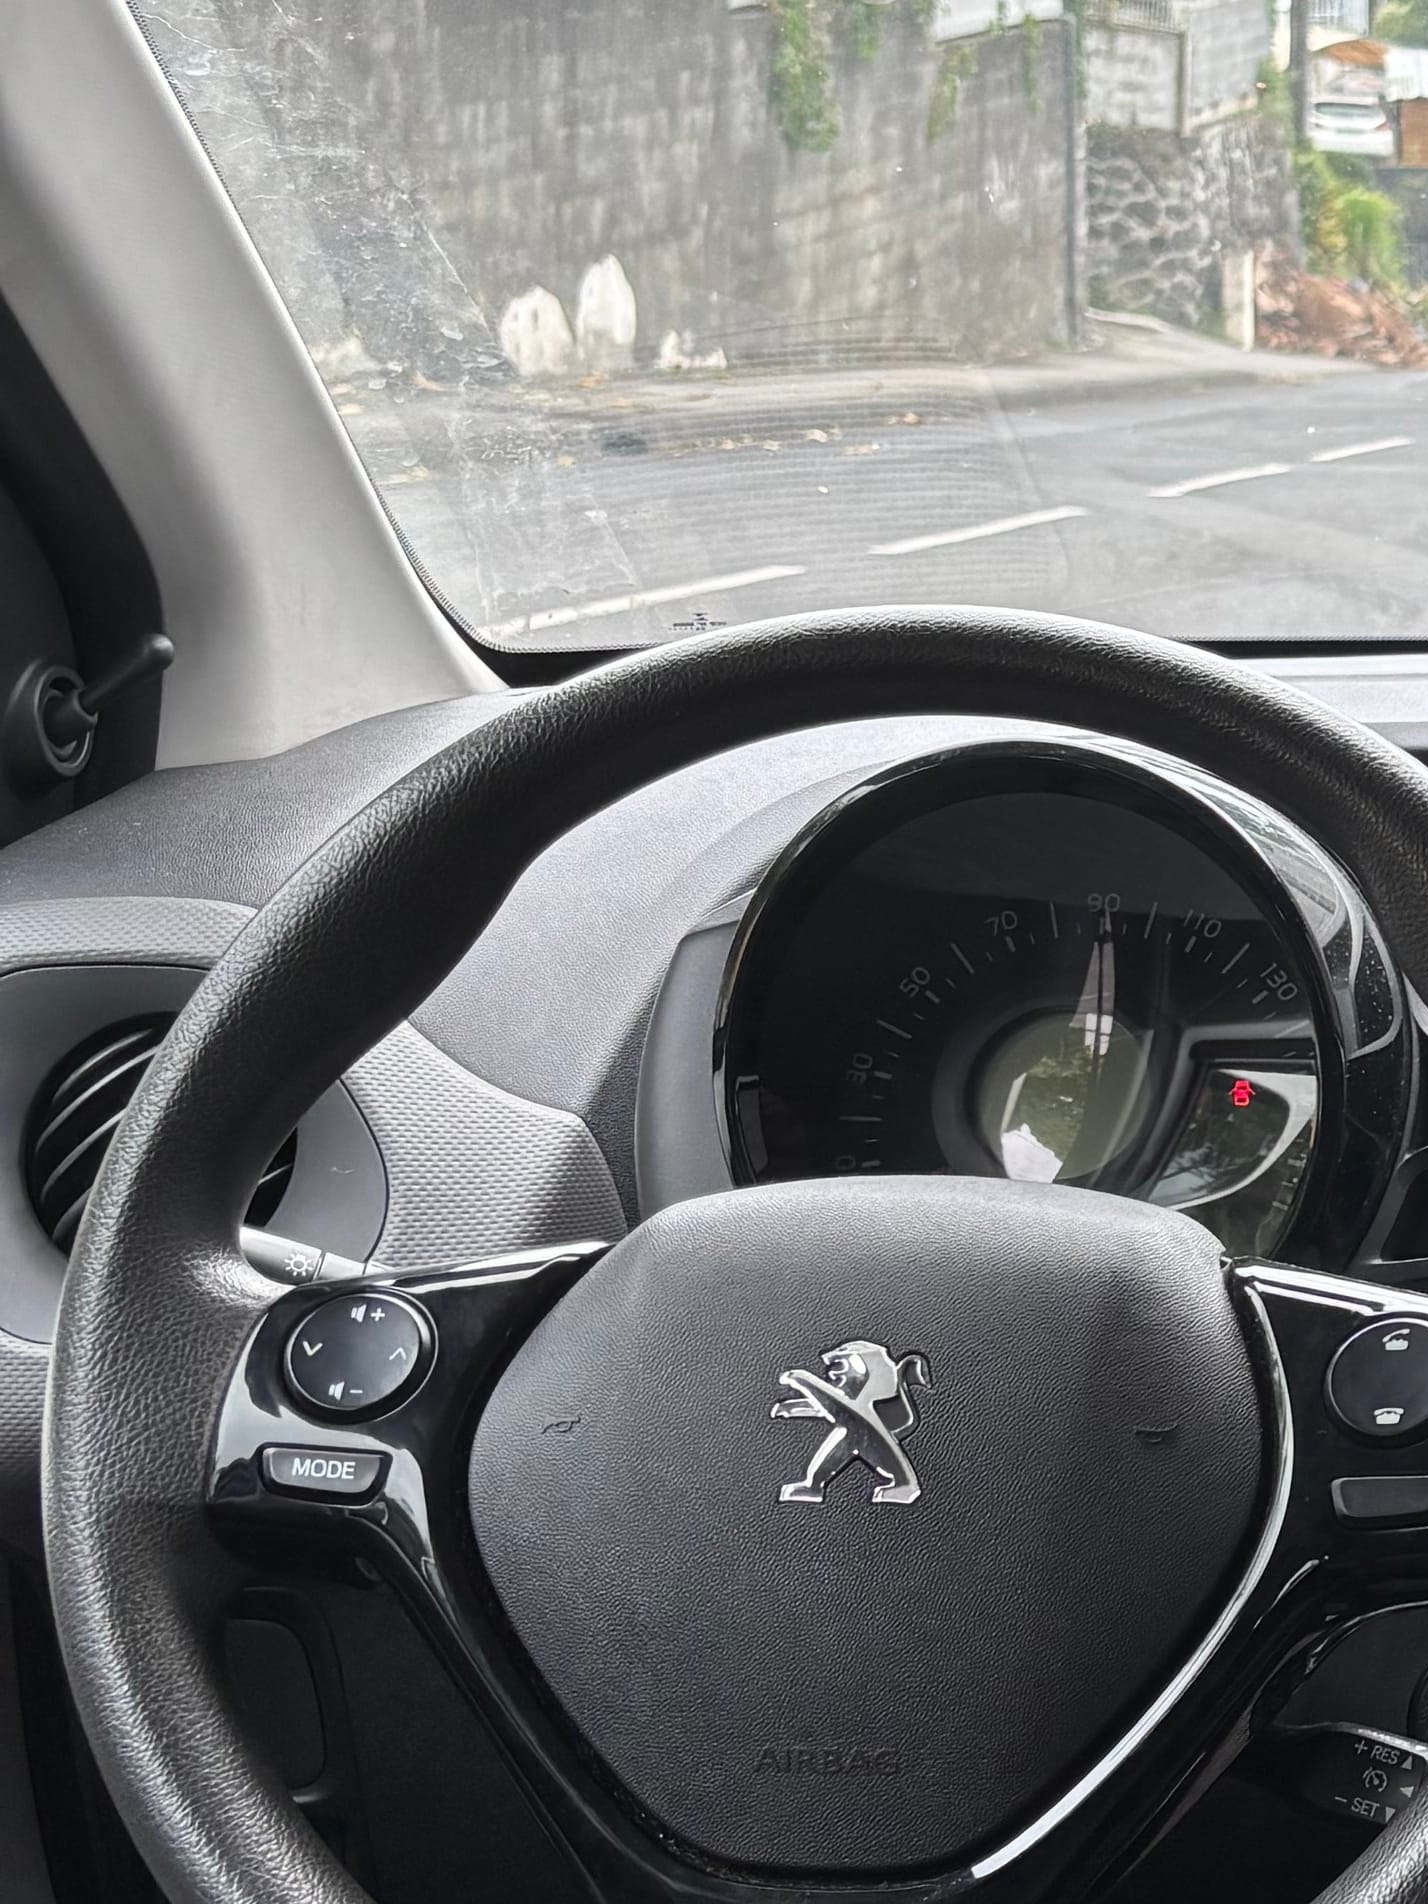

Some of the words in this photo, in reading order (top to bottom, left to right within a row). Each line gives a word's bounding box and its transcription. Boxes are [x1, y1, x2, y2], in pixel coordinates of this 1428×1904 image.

[1087, 892, 1122, 913] 90
[983, 908, 1020, 937] 70
[1182, 907, 1223, 939] 110
[898, 965, 934, 1000] 50
[1258, 961, 1300, 1002] 130
[845, 1050, 874, 1085] 30
[291, 1456, 356, 1480] MODE
[756, 1746, 899, 1776] AIRBAG
[1370, 1745, 1401, 1765] RES
[1351, 1796, 1381, 1818] SET
